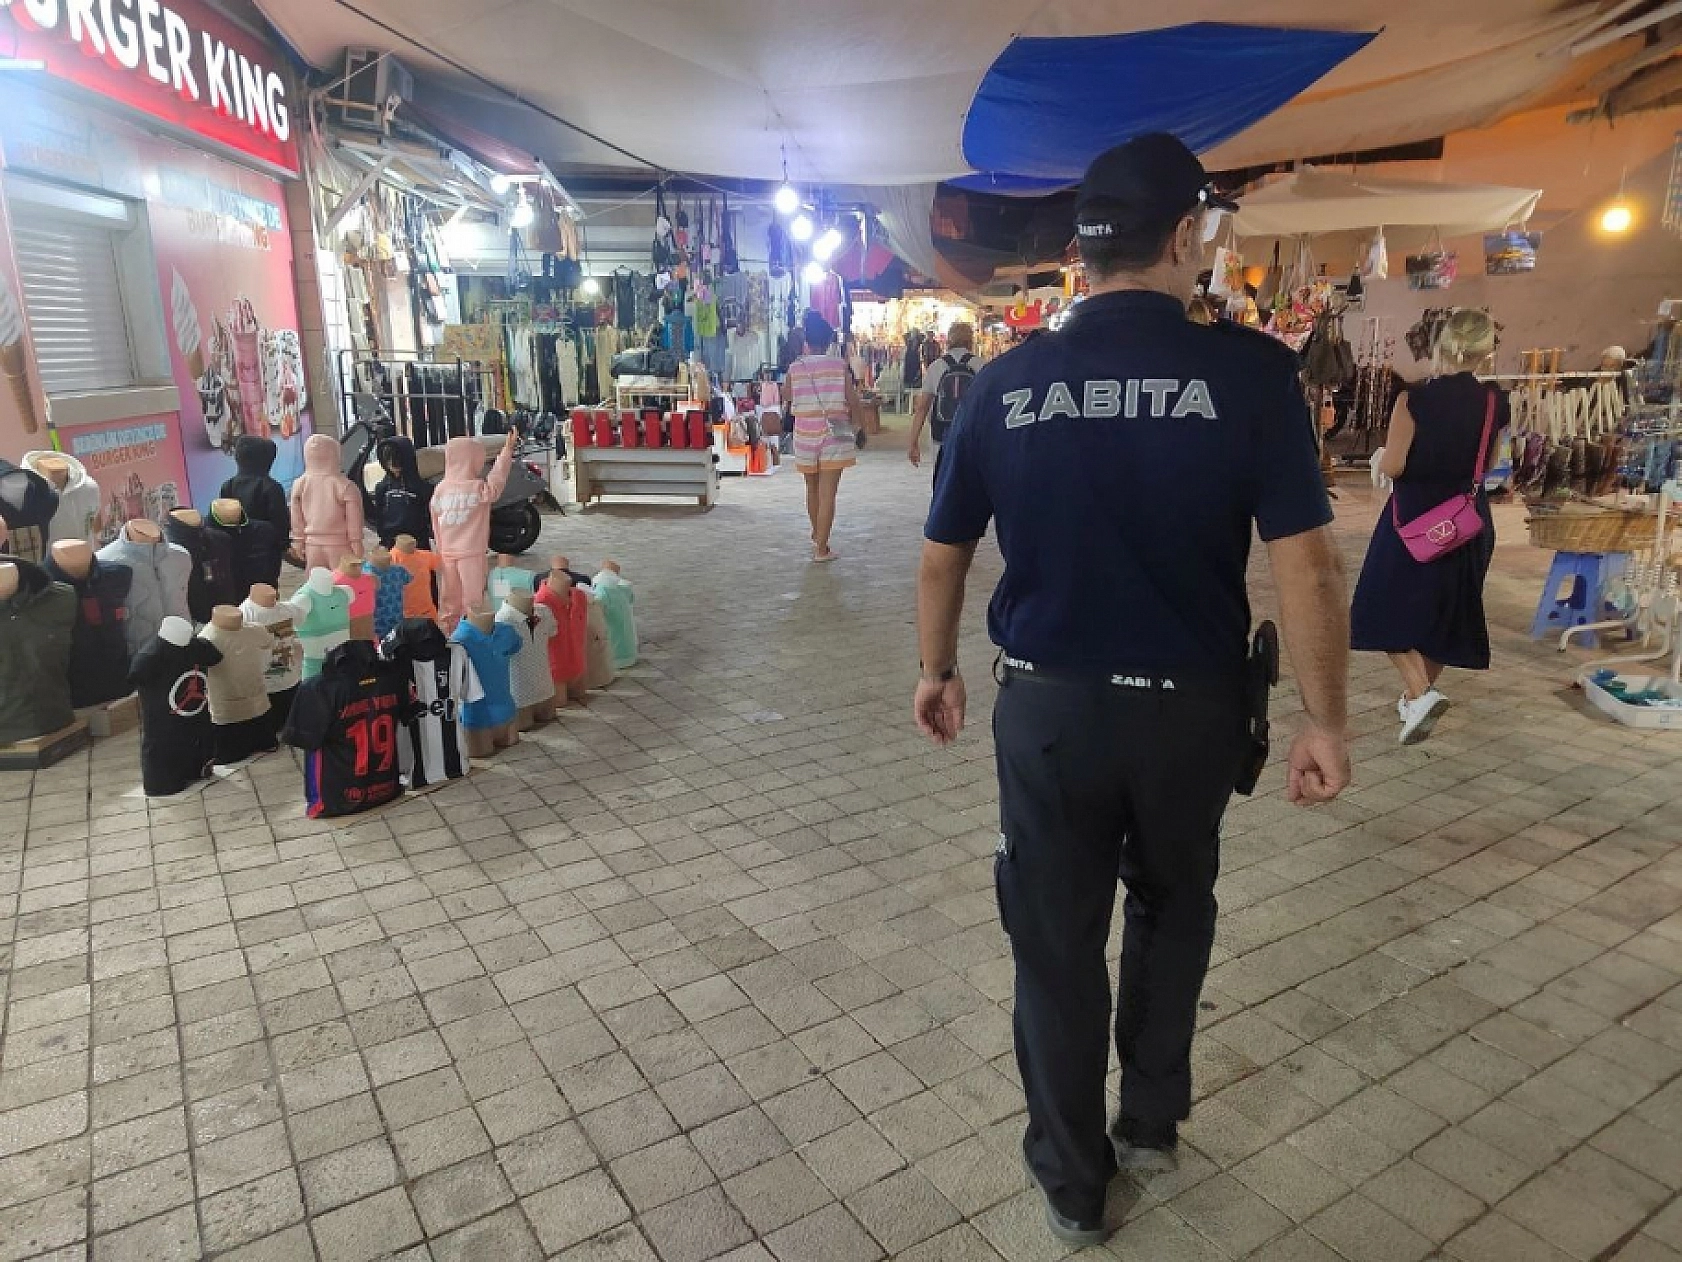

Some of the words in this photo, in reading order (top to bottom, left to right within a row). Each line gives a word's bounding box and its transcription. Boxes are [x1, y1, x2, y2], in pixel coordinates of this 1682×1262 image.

[0, 0, 199, 100] RGER
[202, 31, 290, 142] KING
[1002, 379, 1218, 429] ZABITA
[1111, 674, 1175, 689] ZABIA
[346, 713, 394, 777] 19
